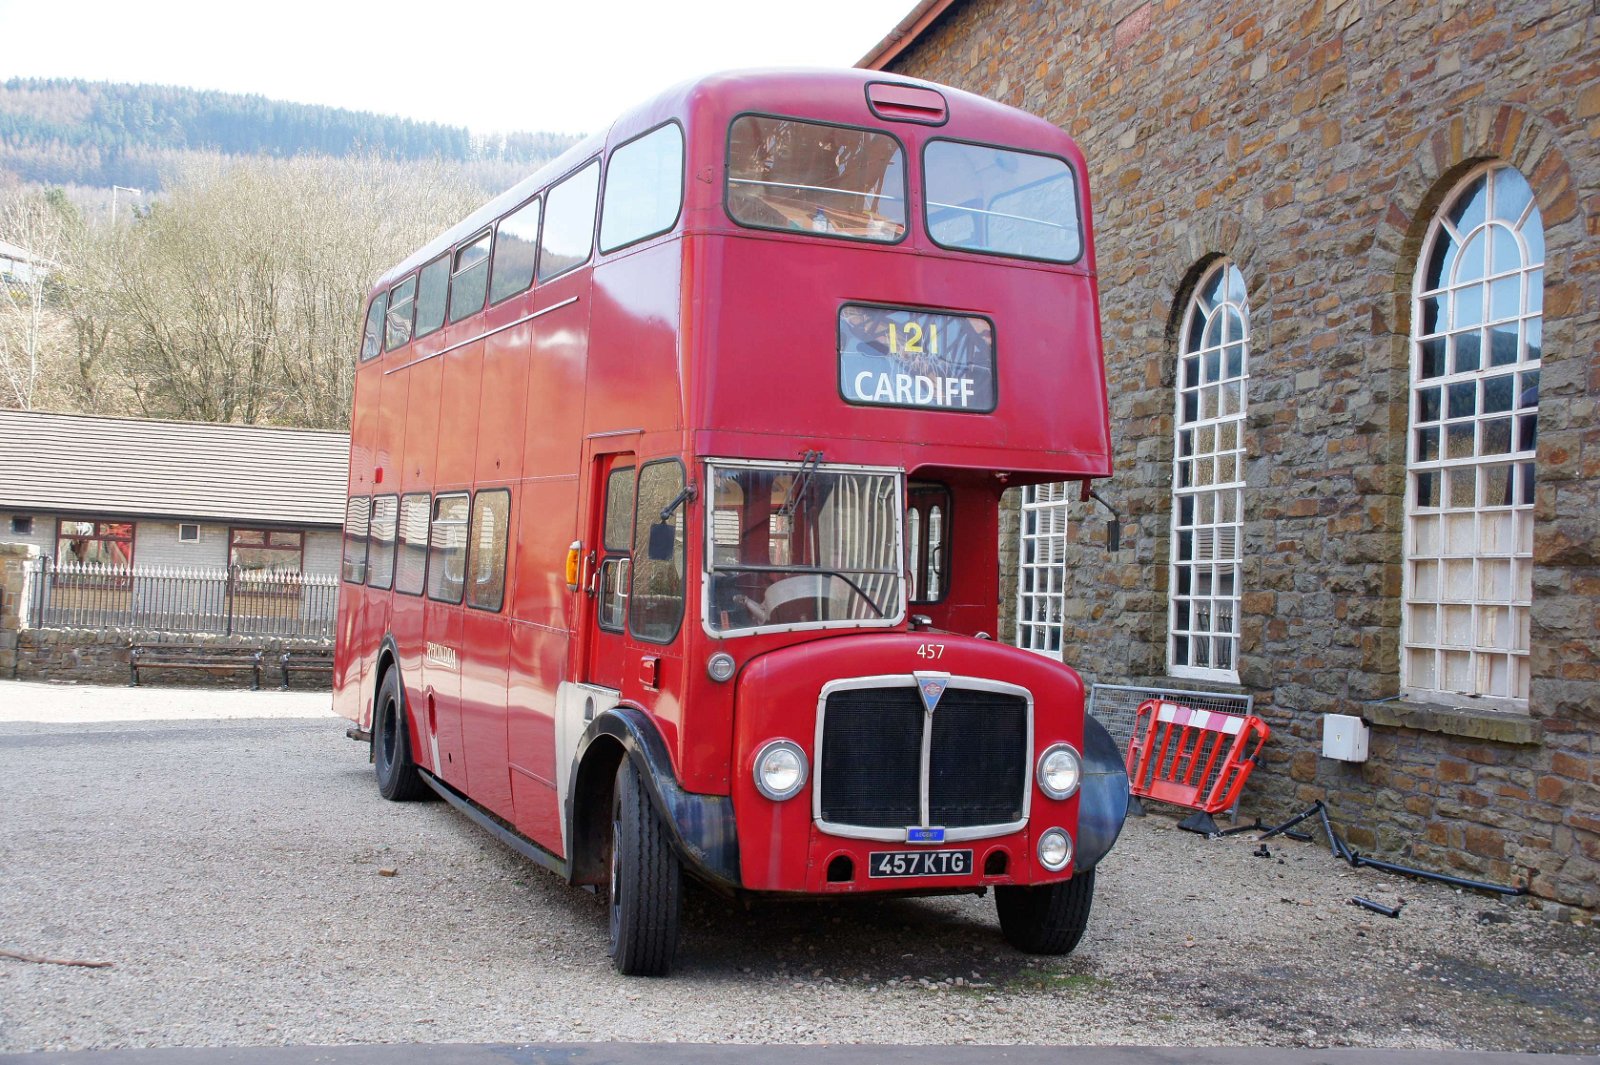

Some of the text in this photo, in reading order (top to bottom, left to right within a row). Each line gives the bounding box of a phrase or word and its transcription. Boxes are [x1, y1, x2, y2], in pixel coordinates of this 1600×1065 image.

[888, 322, 938, 354] 121
[854, 371, 975, 408] CARDIFF
[916, 644, 945, 660] 457
[878, 852, 964, 874] 457 KTG
